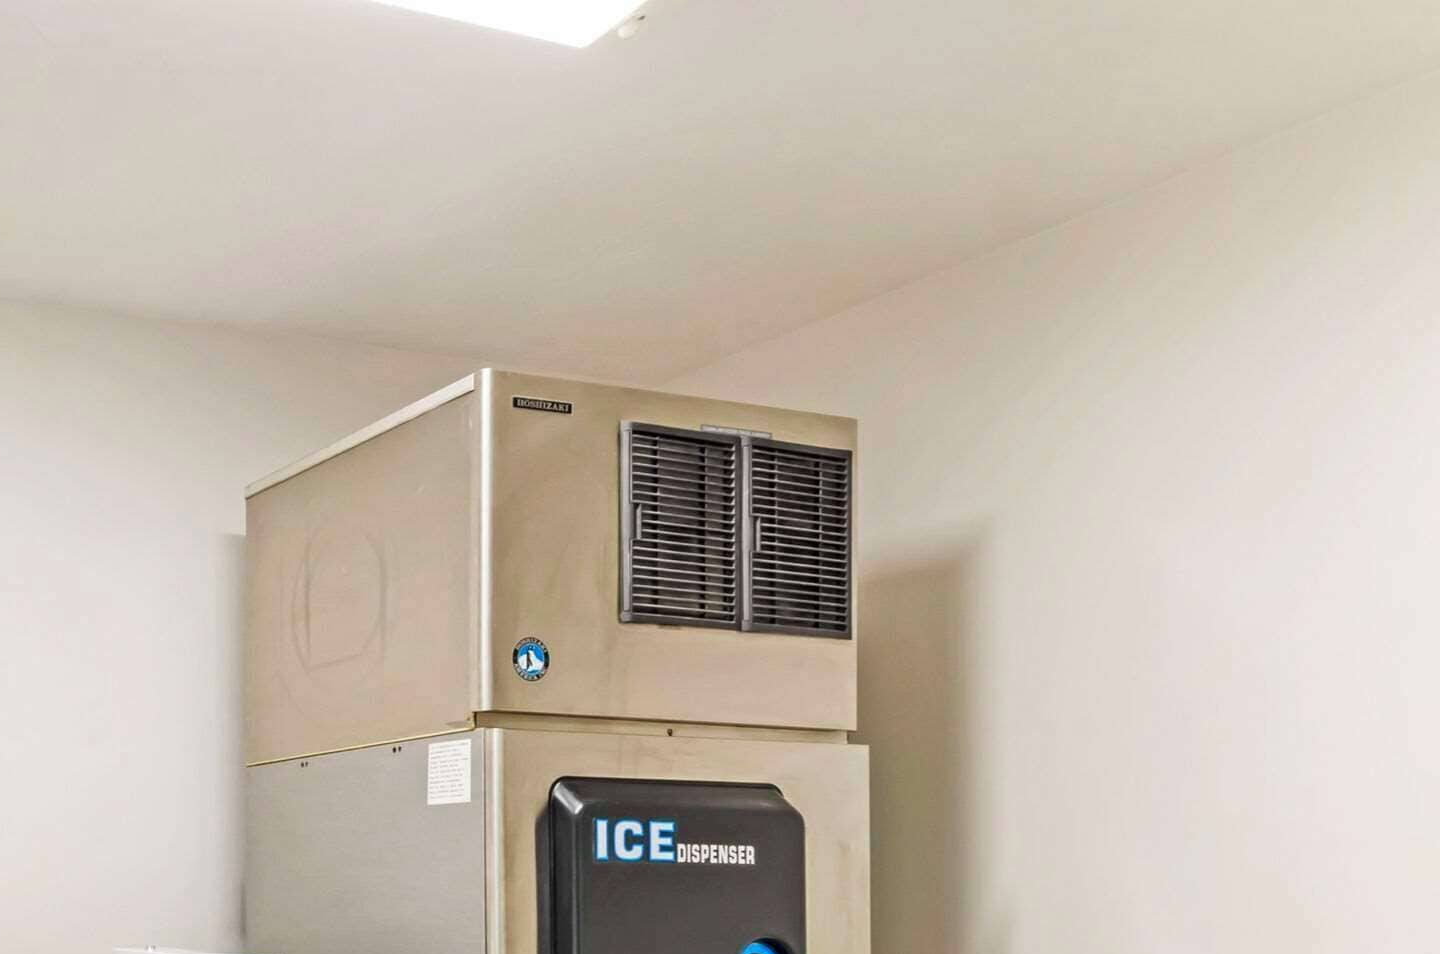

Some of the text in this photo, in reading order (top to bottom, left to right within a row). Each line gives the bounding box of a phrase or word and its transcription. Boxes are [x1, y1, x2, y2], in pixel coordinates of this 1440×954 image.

[516, 399, 570, 412] HOSHIZAKI
[594, 818, 756, 865] ICE DISPENSER
